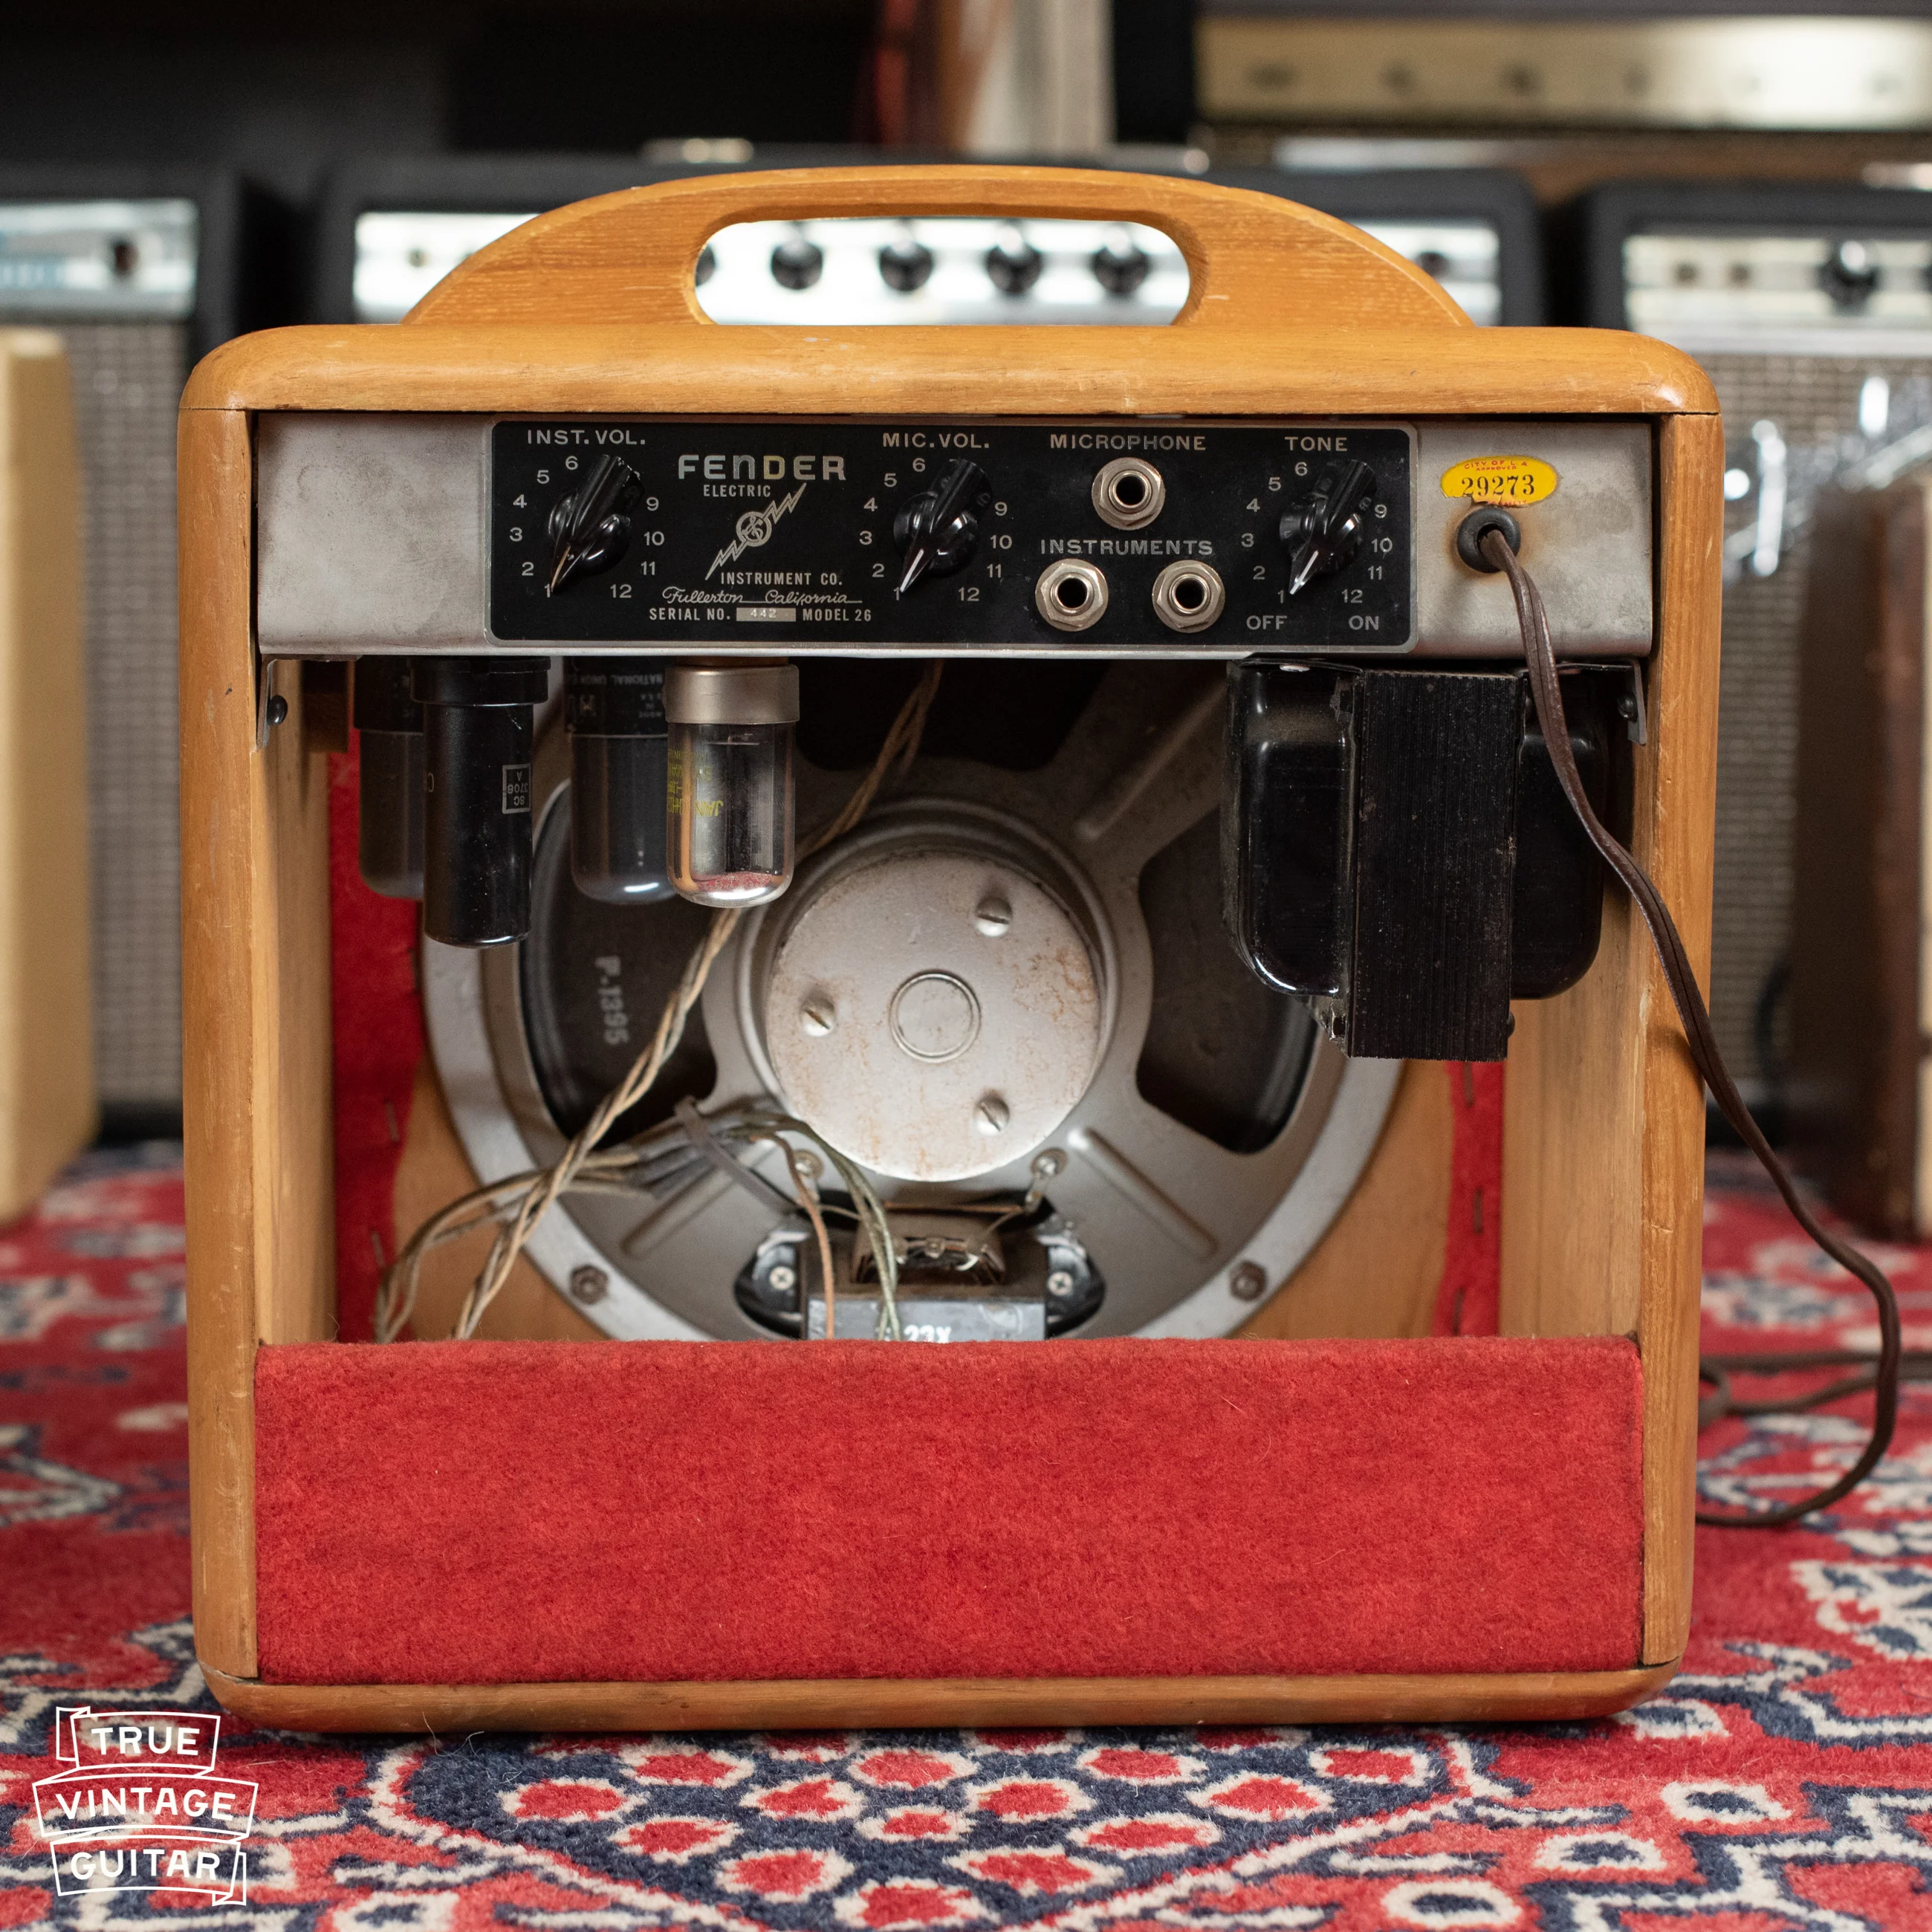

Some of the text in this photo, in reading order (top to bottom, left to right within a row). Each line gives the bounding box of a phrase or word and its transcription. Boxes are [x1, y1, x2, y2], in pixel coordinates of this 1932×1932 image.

[1051, 435, 1205, 450] MICROPHONE
[1285, 437, 1347, 451] TONE
[565, 456, 578, 470] 6
[678, 455, 846, 480] FENDER
[912, 458, 925, 472] 6
[1295, 462, 1307, 476] 6
[537, 470, 549, 484] 5
[884, 473, 897, 487] 5
[1268, 477, 1281, 491] 5
[704, 484, 770, 497] ELECTRIC
[1462, 475, 1534, 496] 29273
[513, 494, 527, 508] 4
[646, 497, 658, 510] 9
[864, 498, 878, 511] 4
[1247, 499, 1260, 512] 4
[995, 502, 1007, 516] 9
[1375, 505, 1387, 518] 9
[510, 527, 522, 542] 3
[644, 531, 664, 545] 10
[860, 531, 872, 545] 3
[1242, 534, 1254, 547] 3
[991, 535, 1012, 549] 10
[1041, 539, 1213, 555] INSTRUMENTS
[1372, 537, 1393, 554] 10
[522, 562, 534, 576] 2
[641, 562, 655, 575] 11
[872, 563, 884, 577] 2
[988, 564, 1001, 577] 11
[1254, 566, 1265, 580] 2
[1368, 566, 1382, 580] 11
[722, 572, 842, 585] INSTRUMENT CO.
[611, 584, 632, 598] 12
[662, 586, 847, 606] Fullerton California
[893, 587, 900, 600] 1
[959, 588, 979, 601] 12
[1278, 590, 1284, 603] 1
[1342, 589, 1362, 603] 12
[649, 608, 871, 621] SERIAL NO. 442 MODEL 26
[1247, 615, 1287, 629] OFF
[1349, 615, 1378, 630] ON
[513, 795, 525, 806] SC
